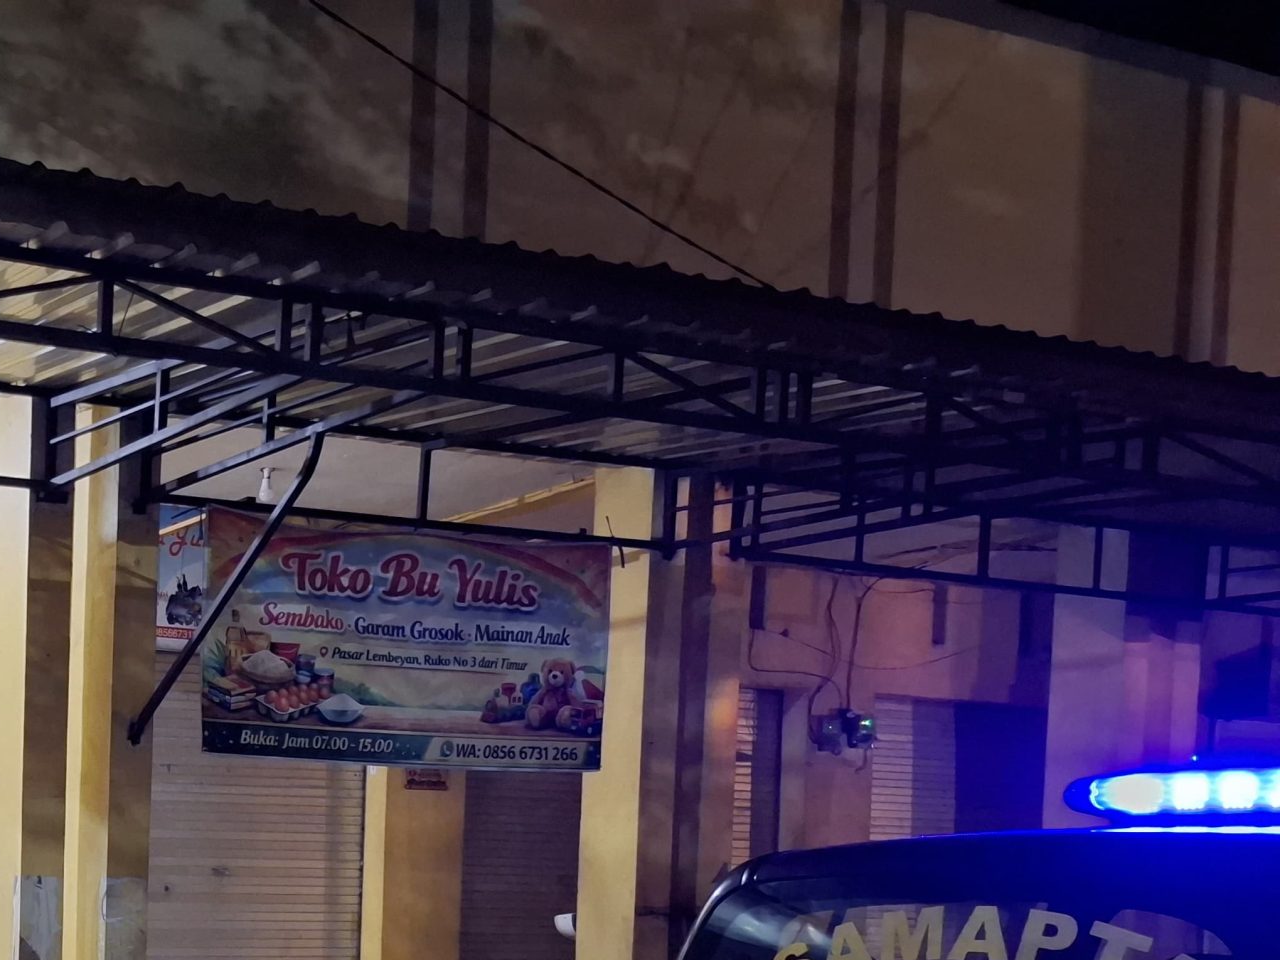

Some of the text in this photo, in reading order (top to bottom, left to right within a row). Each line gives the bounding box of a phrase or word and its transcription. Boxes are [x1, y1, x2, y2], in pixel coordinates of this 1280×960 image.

[280, 551, 539, 608] Toko Bu Yulis
[258, 602, 570, 646] Sembako Garam Grosok Mainan Anak
[331, 647, 364, 661] Pasar
[424, 654, 451, 666] Ruko
[453, 655, 468, 668] No
[470, 656, 477, 668] 3
[478, 657, 499, 670] dari
[500, 658, 529, 672] Timur
[240, 728, 278, 747] Buka:
[282, 732, 310, 750] Jam
[312, 735, 349, 751] 07.00
[358, 737, 394, 753] 15.00
[456, 743, 482, 759] WA:
[483, 744, 516, 760] 0856
[519, 745, 549, 761] 6731
[552, 746, 579, 762] 266
